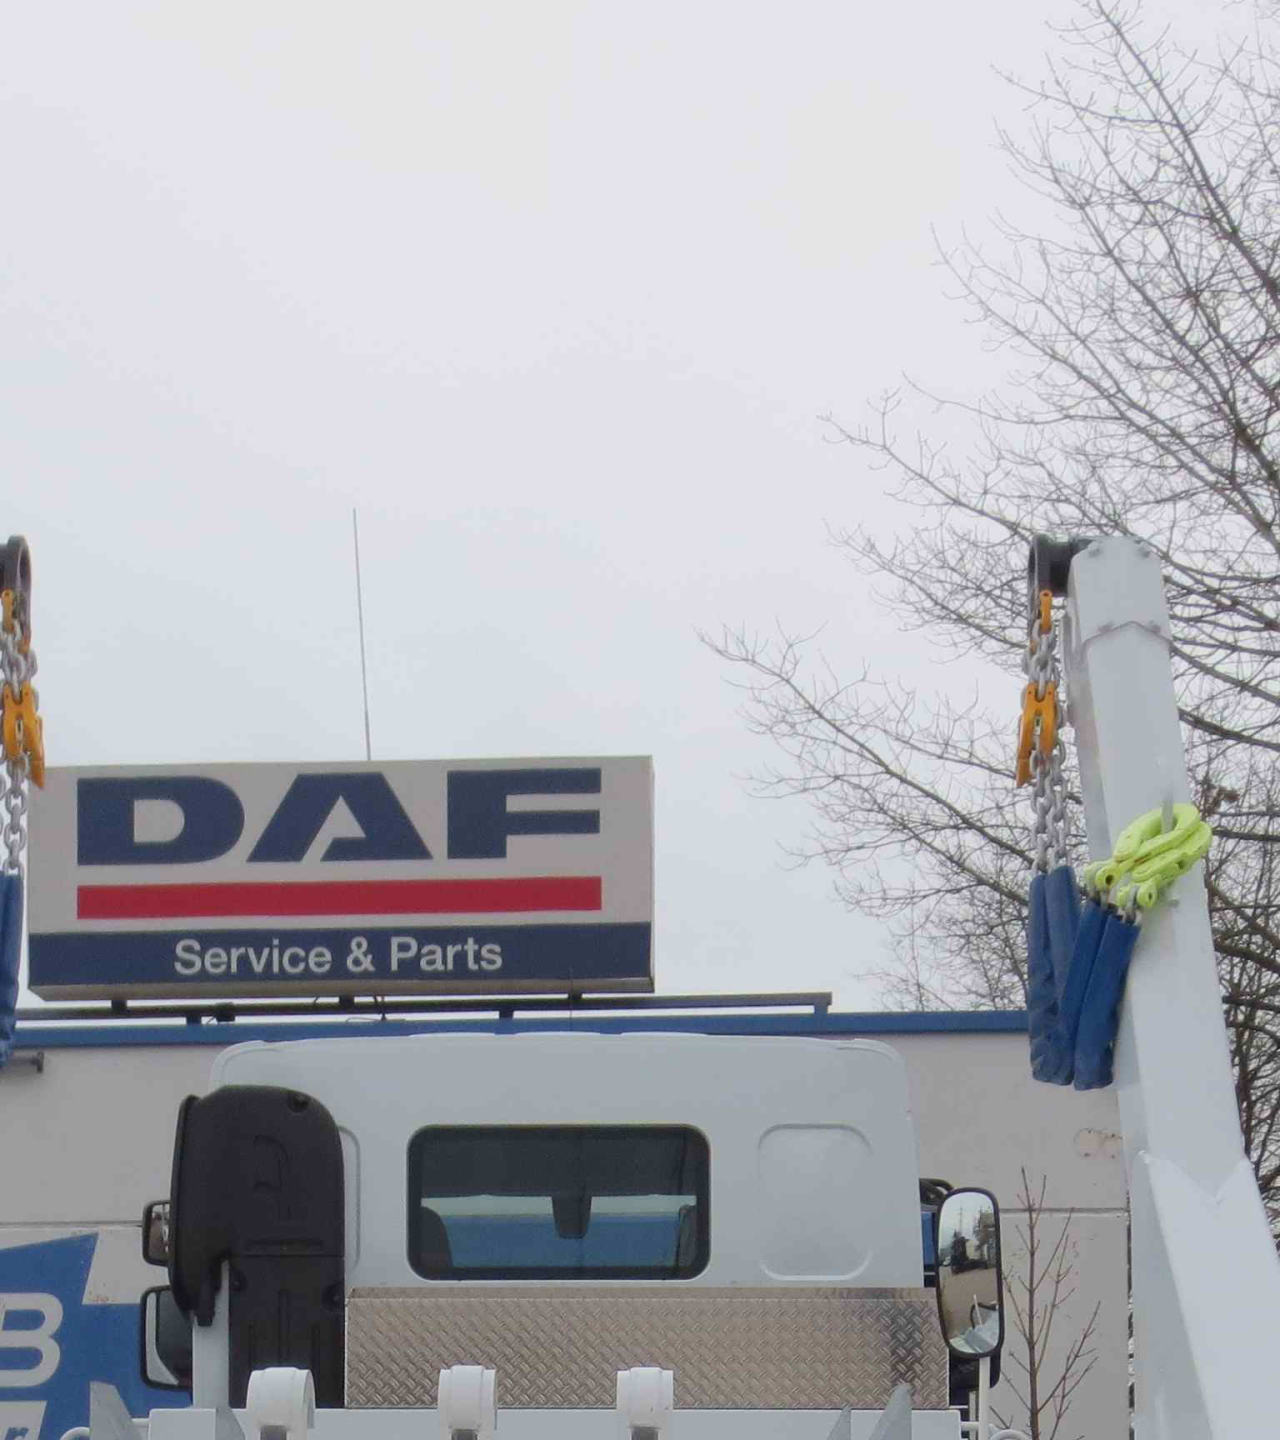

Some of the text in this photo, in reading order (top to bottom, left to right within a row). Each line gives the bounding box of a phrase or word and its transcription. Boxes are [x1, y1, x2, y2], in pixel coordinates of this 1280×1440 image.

[77, 768, 601, 866] DAF
[174, 935, 503, 975] Service & Parts
